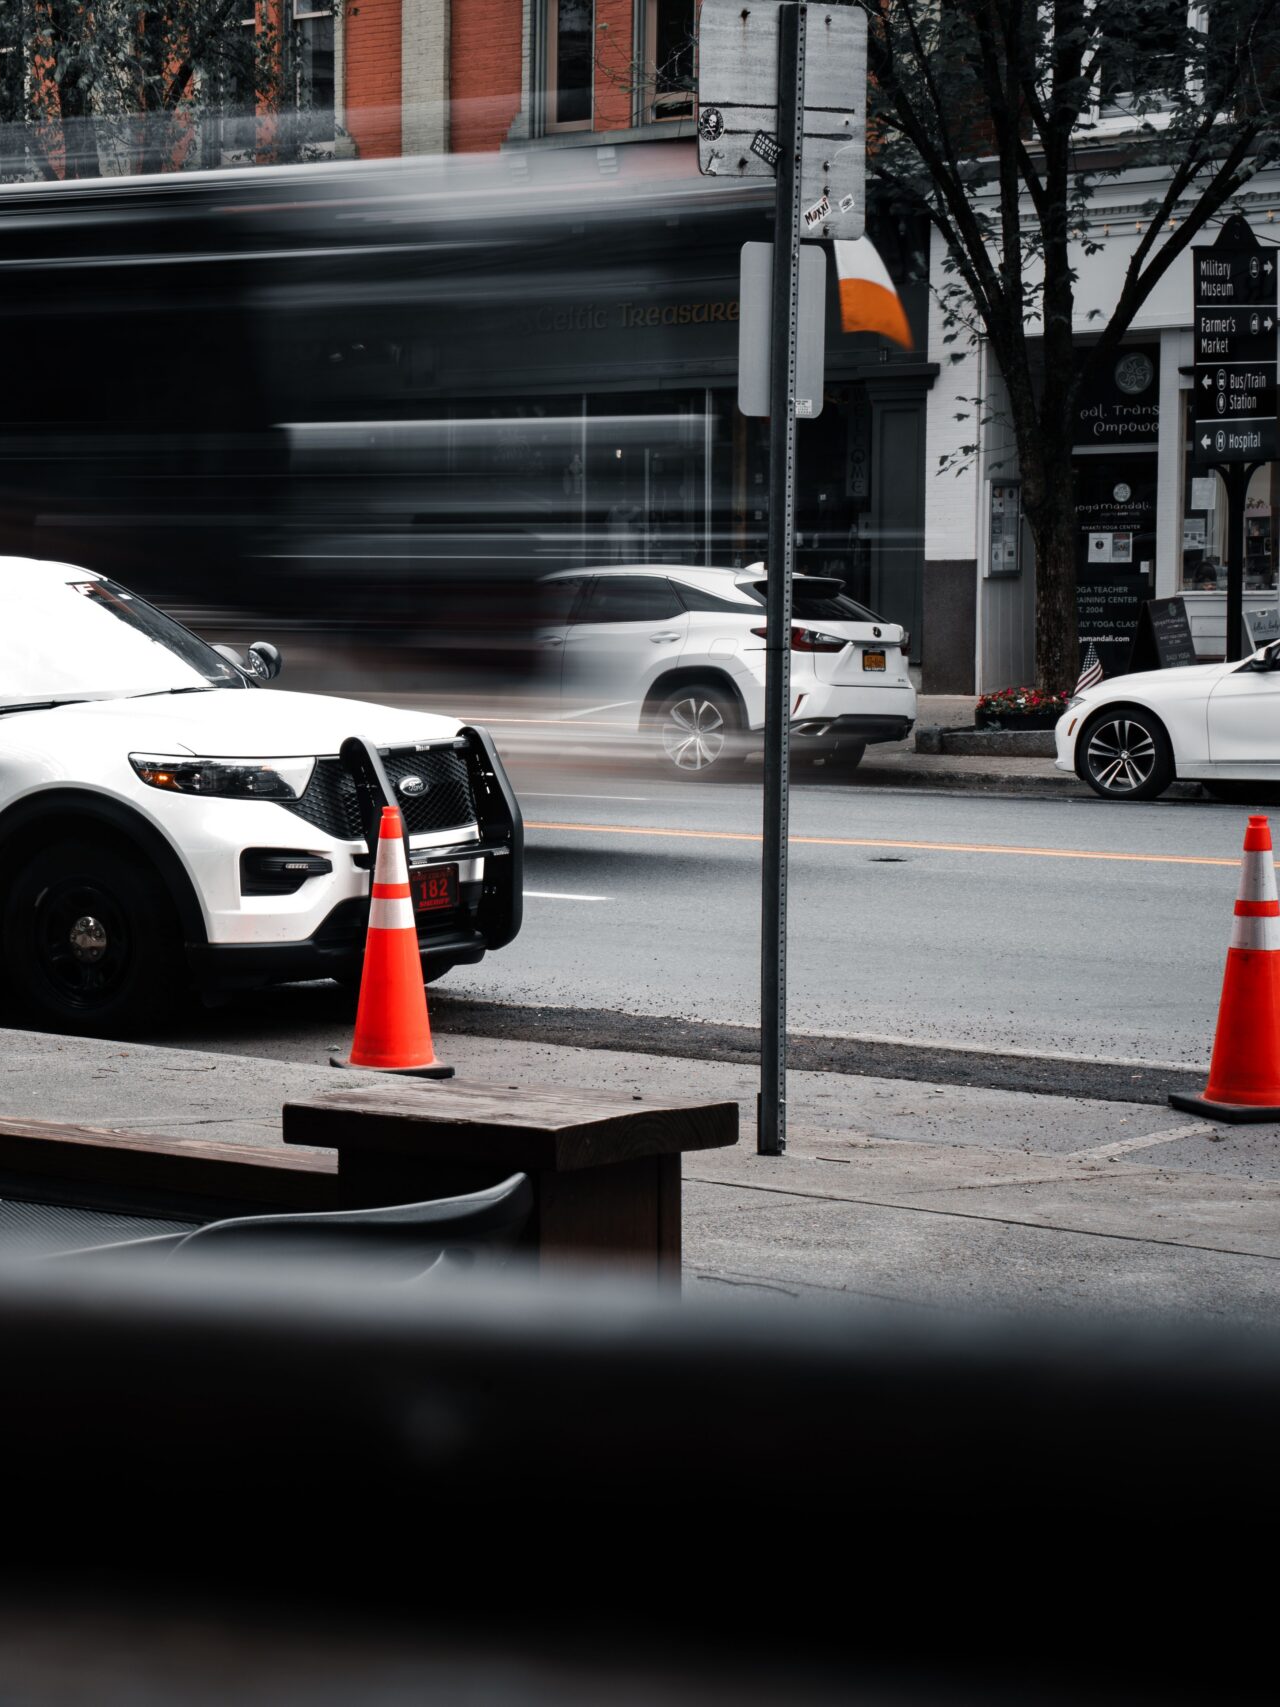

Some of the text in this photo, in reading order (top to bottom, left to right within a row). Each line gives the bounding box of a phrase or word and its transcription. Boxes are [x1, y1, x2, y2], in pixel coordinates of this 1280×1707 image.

[758, 134, 783, 153] ALBANY
[1200, 260, 1231, 280] Military
[1200, 281, 1234, 296] Museum
[537, 304, 608, 331] Celtic
[1201, 316, 1236, 332] Farmer's
[1201, 338, 1229, 353] Market
[1229, 372, 1267, 390] Bus/Train
[1229, 393, 1257, 409] Station
[1229, 431, 1261, 452] Hospital
[420, 879, 449, 900] 182
